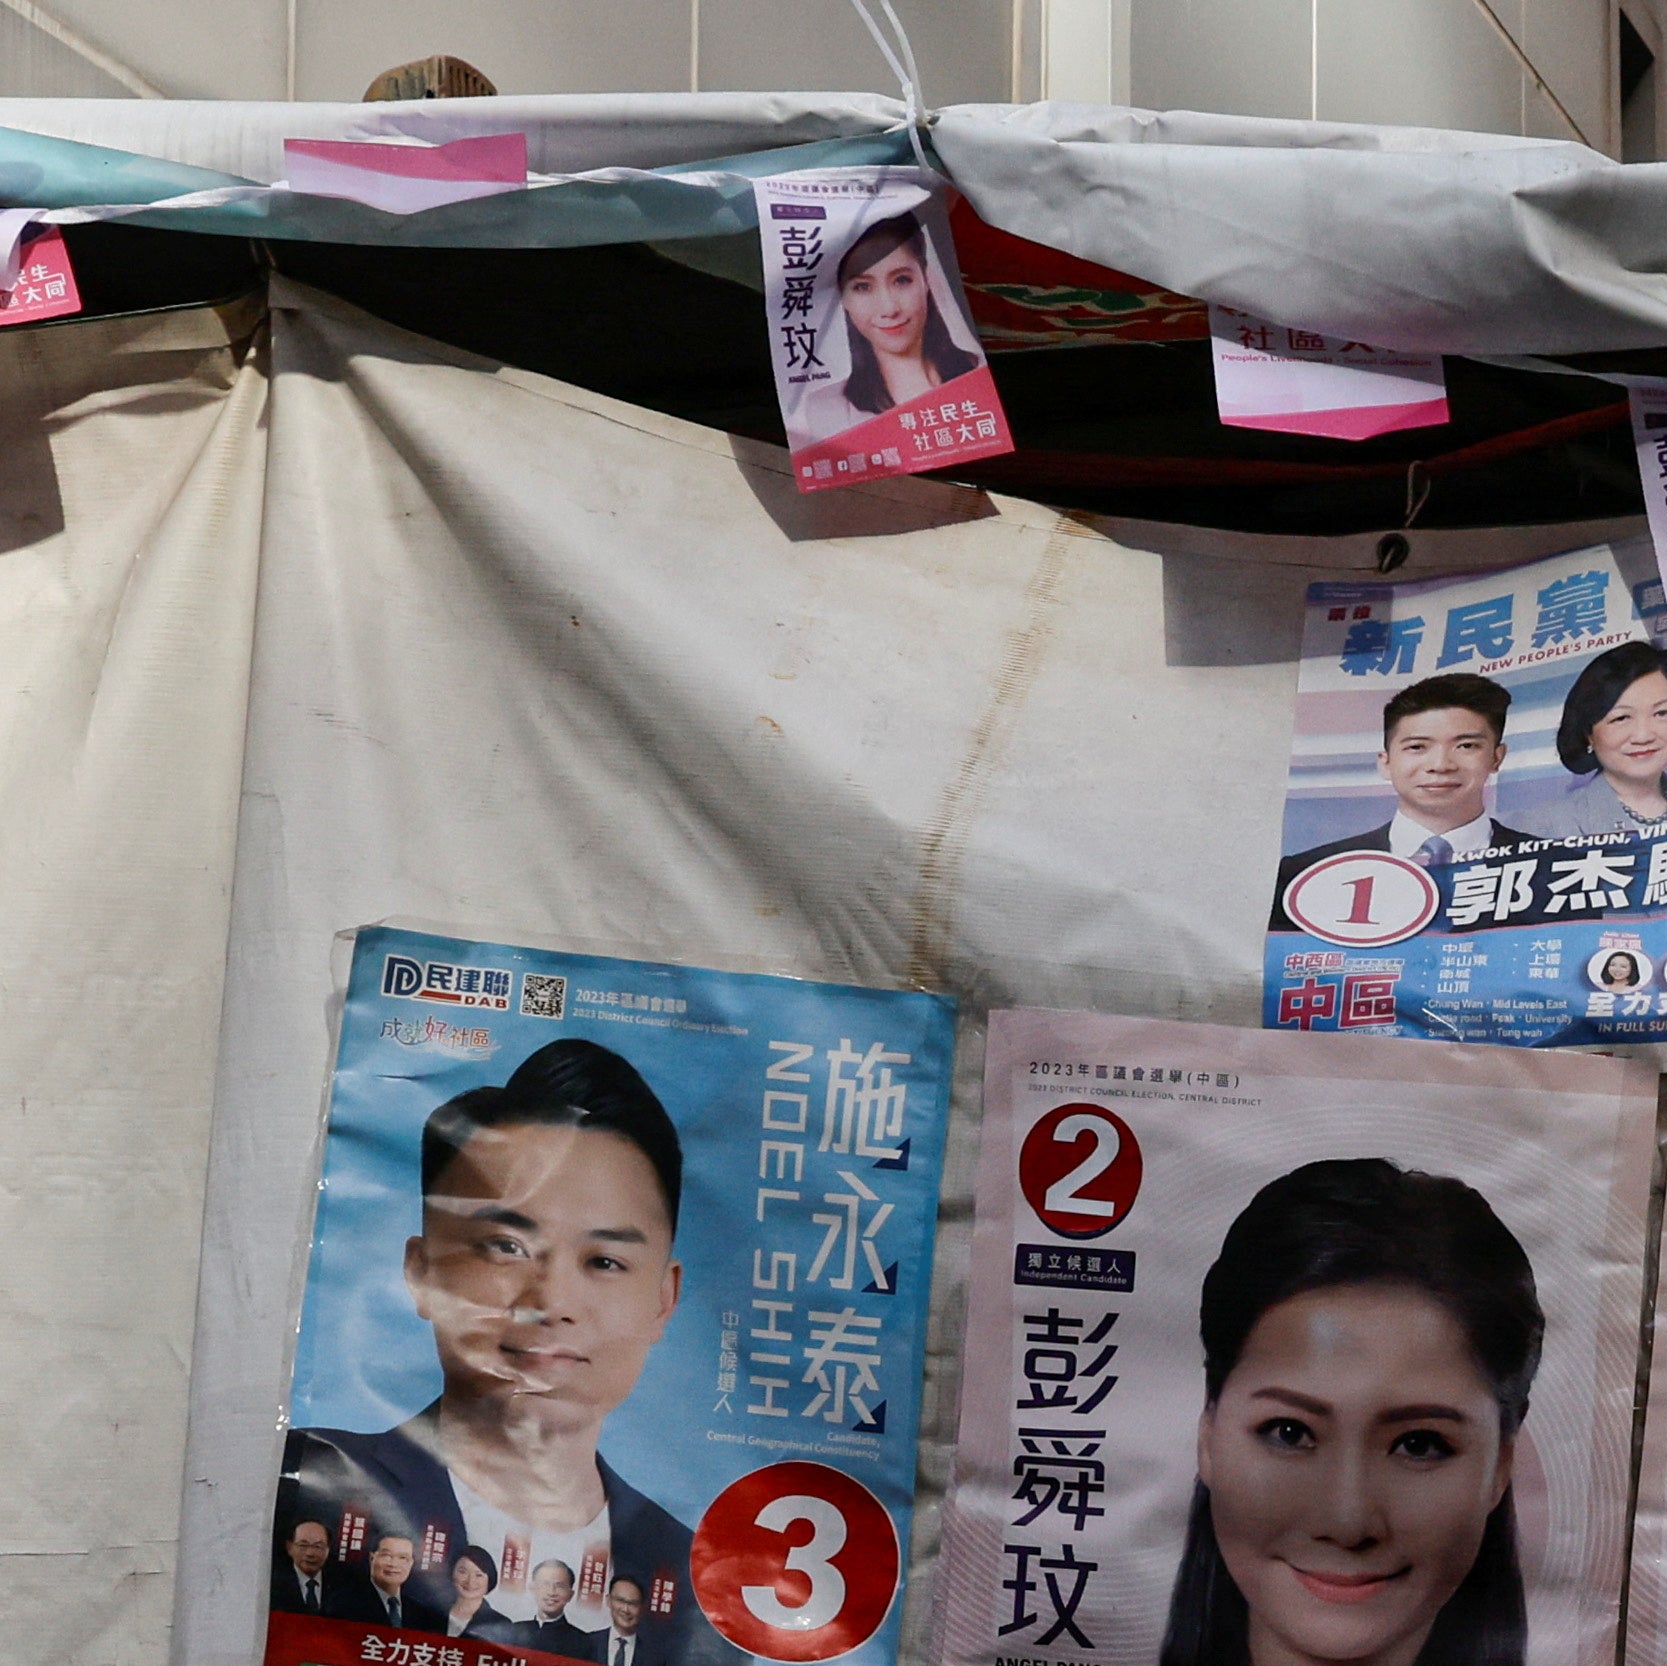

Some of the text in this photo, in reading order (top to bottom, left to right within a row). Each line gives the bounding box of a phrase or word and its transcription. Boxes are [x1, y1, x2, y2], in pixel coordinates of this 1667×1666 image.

[780, 226, 825, 369] 彭舜玟
[1338, 569, 1610, 676] 新民黨
[1479, 630, 1634, 675] NEW PEOPLE'S PARTY
[1450, 844, 1514, 865] KWOK
[1517, 828, 1633, 860] KIT-CHUN,
[1339, 875, 1382, 926] 1
[426, 964, 511, 998] 民建聯
[464, 996, 508, 1011] DAB
[1278, 972, 1401, 1032] 中區
[1029, 1061, 1241, 1089] 2023年區議會選舉(中區)
[1043, 1112, 1121, 1219] 2
[746, 1039, 816, 1419] NOEL SHIH
[800, 1036, 912, 1426] 施永泰
[1026, 1250, 1122, 1275] 獨立候選人
[997, 1306, 1121, 1652] 彭舜玟
[740, 1493, 850, 1633] 3
